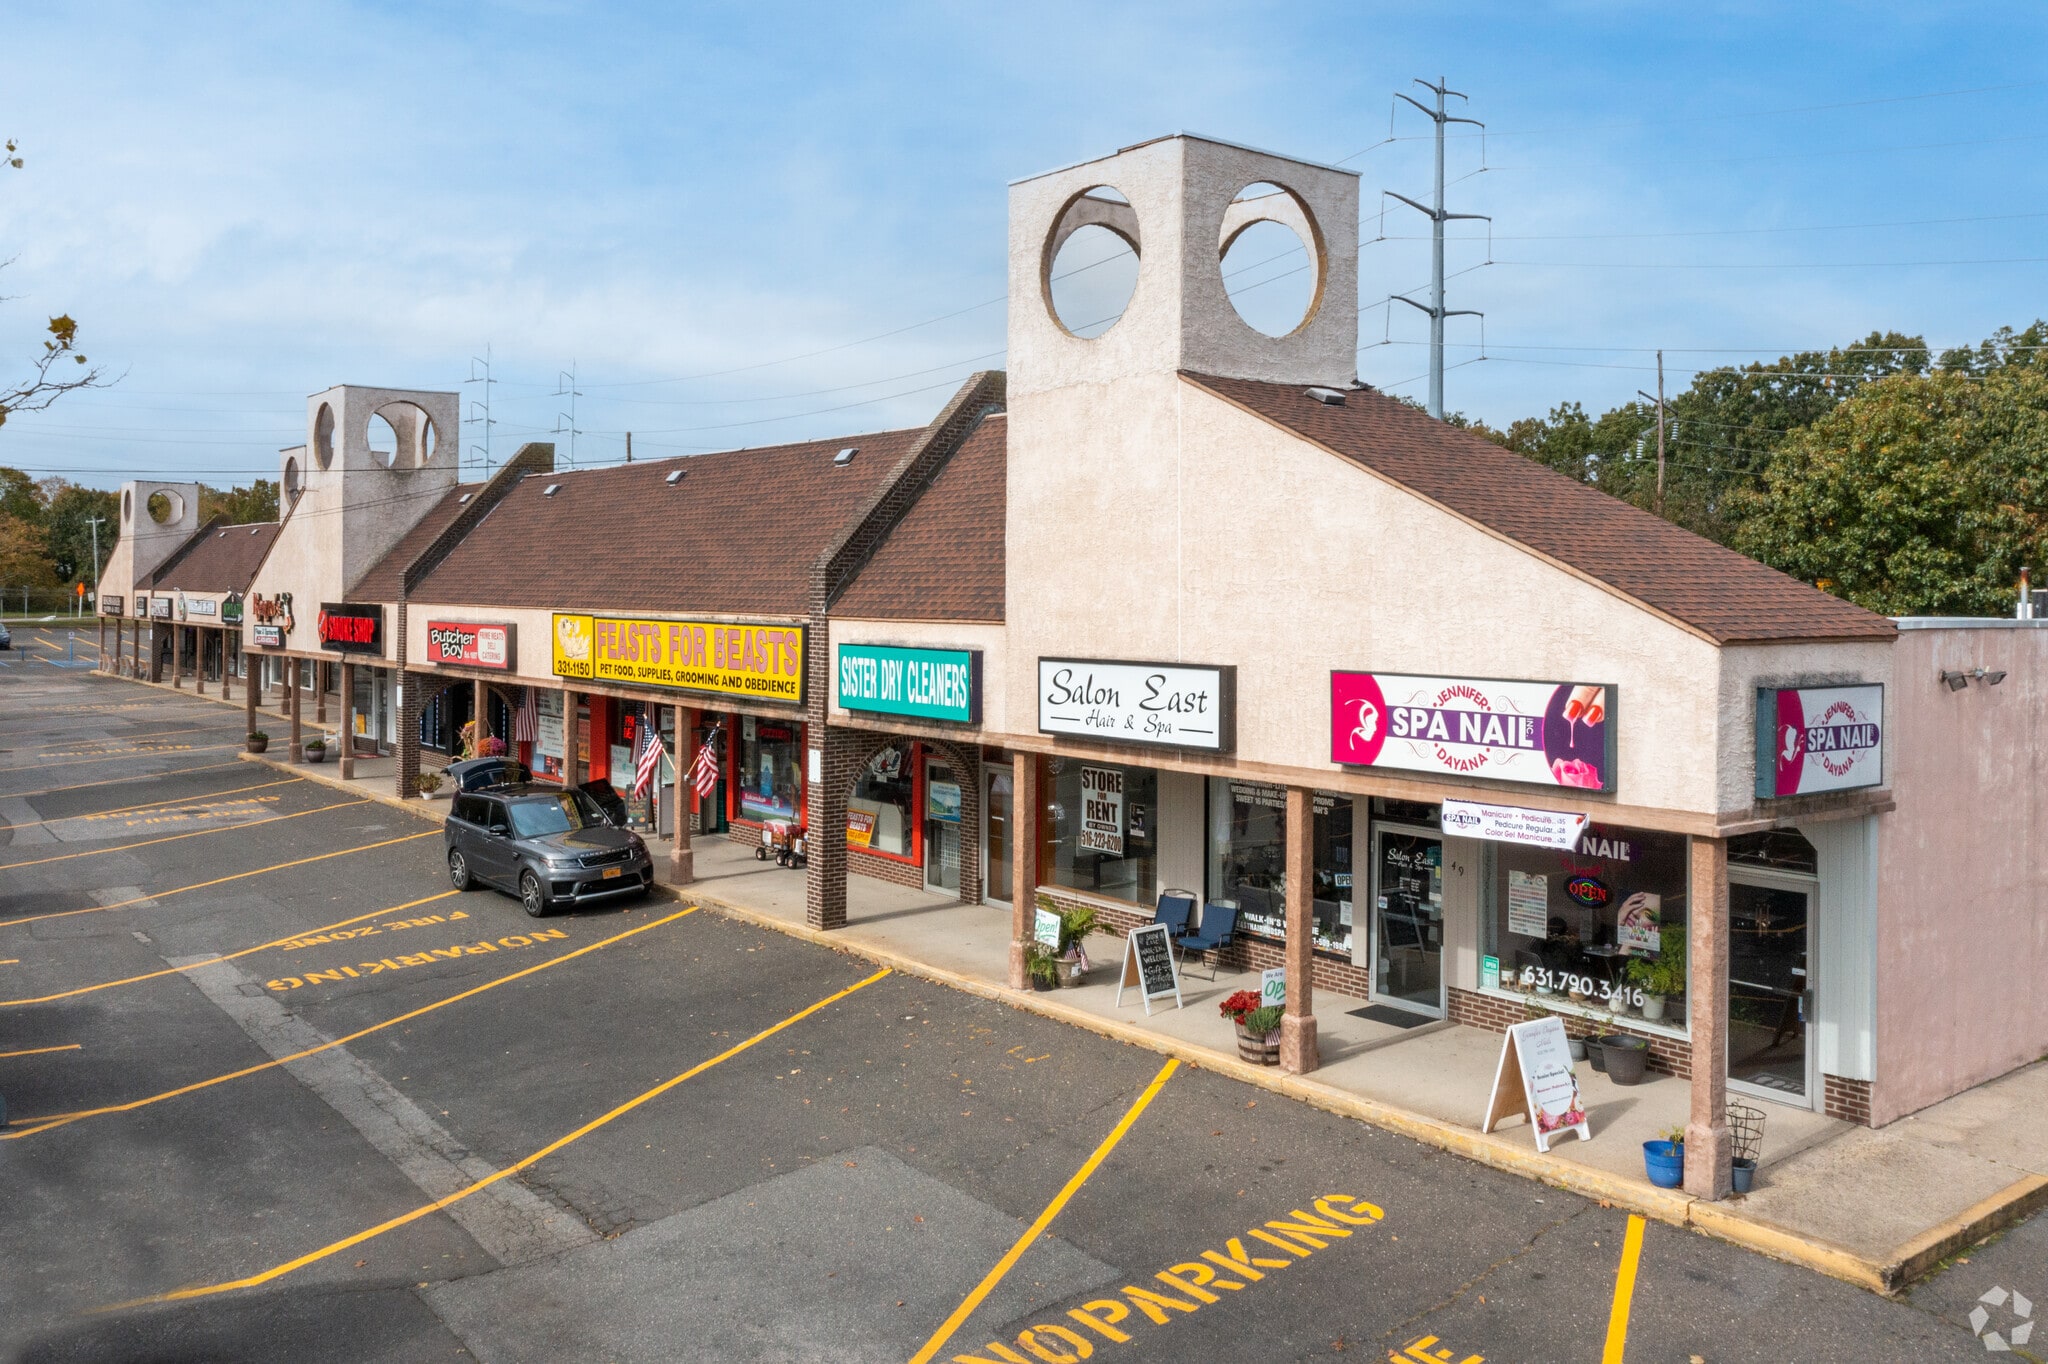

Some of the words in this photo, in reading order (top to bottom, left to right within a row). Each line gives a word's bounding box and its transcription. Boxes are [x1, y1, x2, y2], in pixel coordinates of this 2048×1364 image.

[328, 616, 353, 641] SMOKE
[354, 617, 374, 643] SHOP
[429, 627, 476, 645] Butcher
[441, 643, 463, 659] Boy
[597, 622, 661, 664] FEASTS
[669, 625, 707, 667] FOR
[714, 627, 799, 677] BEASTS
[600, 663, 612, 674] PET
[614, 665, 636, 679] FOOD,
[637, 667, 673, 683] SUPPLIES,
[675, 671, 719, 687] GROOMING
[721, 676, 742, 689] AND
[744, 680, 796, 694] OBEDIENCE
[841, 656, 877, 699] SISTER
[881, 659, 903, 701] DRY
[907, 660, 967, 709] CLEANERS
[1047, 668, 1121, 708] Salon
[1139, 674, 1208, 714] East
[1438, 685, 1488, 711] JENNIFER
[1085, 709, 1116, 728] Hair
[1124, 714, 1135, 730] &
[1144, 713, 1172, 738] Spa
[1824, 701, 1855, 725] JENNIFER
[1392, 708, 1450, 741] SPA
[1459, 712, 1534, 748] NAIL
[1808, 728, 1836, 751] SPA
[1841, 725, 1874, 748] NAIL
[1436, 748, 1488, 772] DAYANA
[1823, 757, 1854, 777] DAYANA
[1082, 769, 1122, 793] STORE
[1230, 784, 1256, 796] WEDDING
[1097, 791, 1107, 800] FOR
[1236, 794, 1254, 803] SWEET
[1313, 796, 1335, 807] PROMS
[1086, 799, 1118, 823] RENT
[1446, 814, 1461, 822] SPA
[1482, 809, 1513, 819] Manicure
[1485, 828, 1503, 837] Color
[1495, 820, 1524, 830] Pedicure
[1387, 848, 1410, 861] Salon
[1415, 852, 1434, 865] East
[1583, 837, 1630, 861] NAIL
[1569, 883, 1606, 901] OPEN
[382, 911, 470, 930] FIRE
[1244, 912, 1281, 924] WALK-IN'S
[498, 928, 570, 948] NO
[266, 941, 500, 991] PARKING
[1525, 965, 1644, 1007] 631.790.3416
[1067, 1194, 1385, 1344] PARKING
